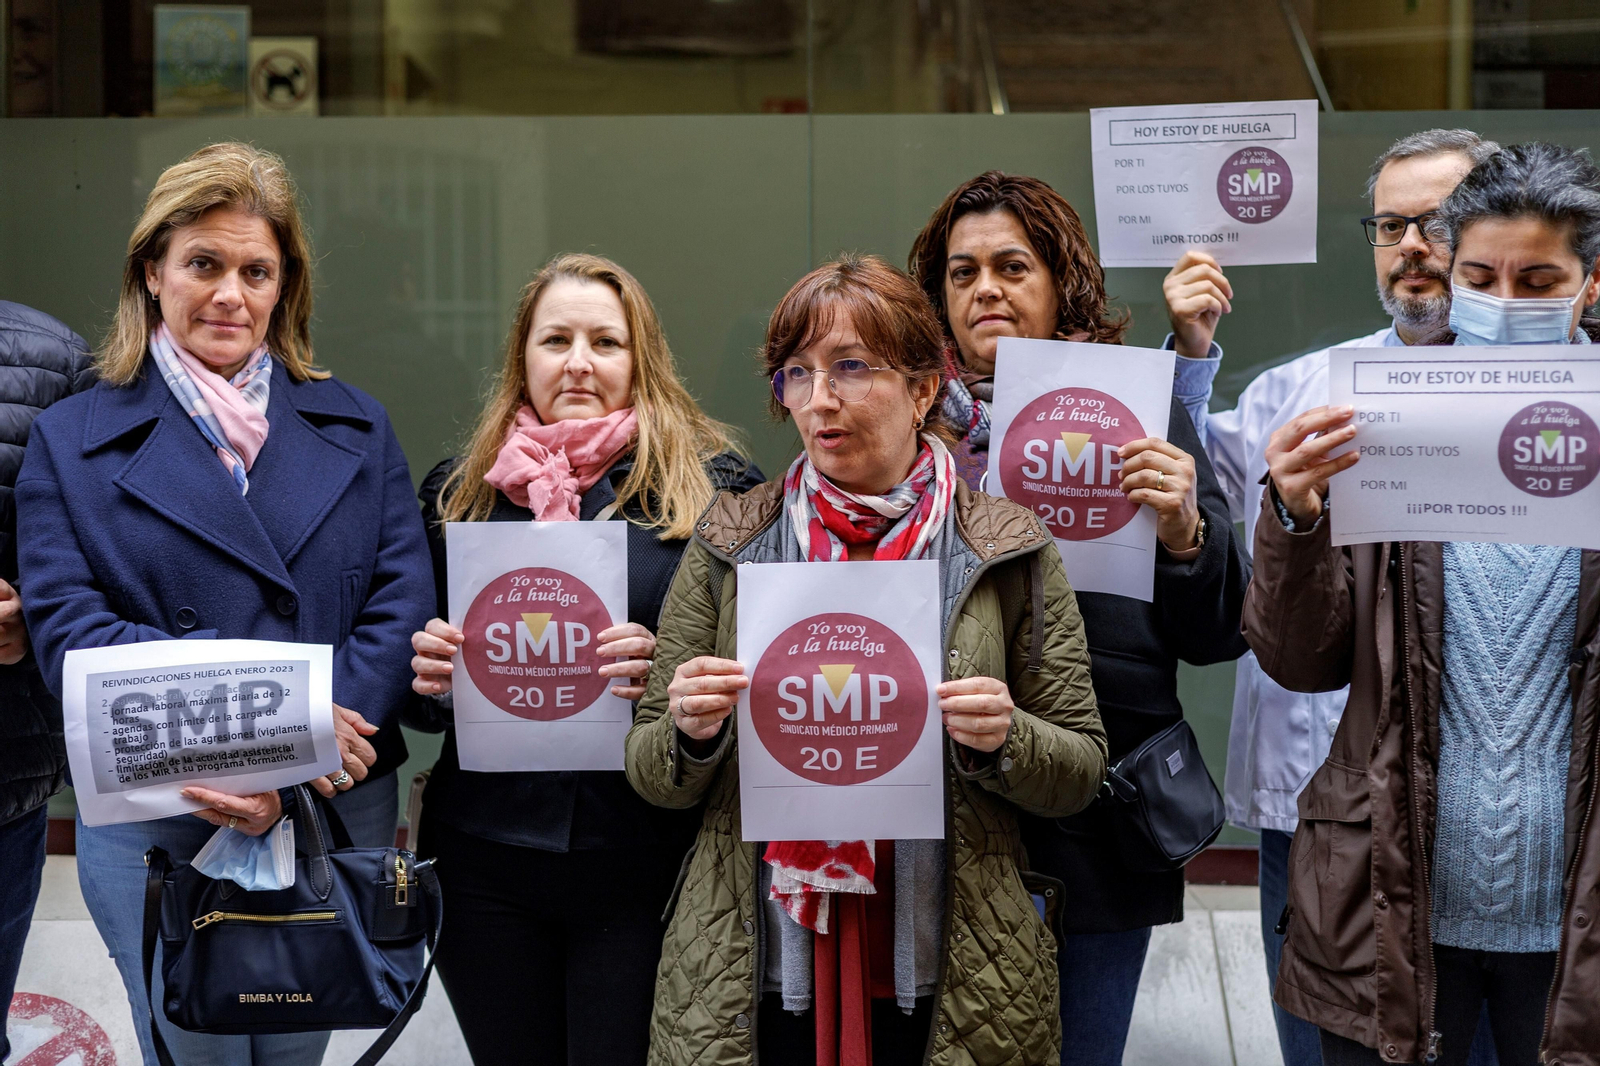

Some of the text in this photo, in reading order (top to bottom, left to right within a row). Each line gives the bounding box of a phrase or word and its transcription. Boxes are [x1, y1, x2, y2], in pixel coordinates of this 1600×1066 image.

[1134, 122, 1271, 138] HOY ESTOY DE HUELGA
[1114, 158, 1144, 168] POR TI
[1250, 156, 1275, 166] huelga
[1116, 184, 1188, 194] POR LOS TUYOS
[1228, 172, 1281, 195] SMP
[1237, 205, 1272, 218] 20 E
[1118, 215, 1151, 224] POR MI
[1187, 234, 1223, 244] TODOS
[1227, 233, 1239, 242] !!!
[1388, 370, 1574, 384] HOY ESTOY DE HUELGA
[1055, 394, 1105, 411] Yo voy
[1533, 406, 1547, 414] Yo
[1036, 407, 1120, 429] a la huelga
[1359, 412, 1400, 422] POR TI
[1530, 415, 1541, 424] la
[1544, 414, 1580, 427] huelga
[1360, 445, 1460, 457] POR LOS TUYOS
[1513, 436, 1587, 464] SMP
[1021, 439, 1125, 485] SMP
[1022, 481, 1057, 495] SINDICATO
[1059, 483, 1089, 497] MÉDICO
[1360, 480, 1407, 490] POR MI
[1526, 477, 1574, 490] 20 E
[1038, 504, 1107, 528] 20 E
[1457, 504, 1506, 515] TODOS
[1511, 505, 1527, 516] !!!
[510, 575, 562, 589] Yo voy
[494, 588, 579, 607] a la huelga
[808, 622, 866, 638] Yo voy
[485, 621, 590, 663] SMP
[788, 636, 886, 657] a la huelga
[102, 672, 191, 688] REIVINDICACIONES
[194, 669, 231, 679] HUELGA
[235, 667, 266, 675] ENERO
[488, 665, 591, 676] SINDICATO MÉDICO PRIMARIA
[102, 699, 111, 707] 2.
[145, 692, 180, 702] Laboral
[111, 705, 148, 718] jornada
[152, 700, 186, 710] laboral
[190, 696, 228, 707] máxima
[232, 692, 259, 701] diaria
[263, 690, 274, 698] de
[507, 686, 576, 708] 20 E
[777, 674, 898, 721] SMP
[110, 680, 284, 754] SMP
[113, 715, 139, 725] horas
[113, 723, 152, 736] agendas
[157, 721, 173, 729] con
[178, 717, 205, 727] límite
[209, 715, 220, 723] de
[224, 713, 232, 721] la
[236, 710, 262, 720] carga
[266, 708, 277, 716] de
[780, 723, 898, 736] SINDICATO MÉDICO PRIMARIA
[114, 734, 148, 744] trabajo
[115, 741, 165, 756] protección
[169, 739, 181, 747] de
[185, 737, 197, 745] las
[202, 730, 254, 744] agresiones
[258, 724, 308, 738] (vigilantes
[116, 750, 168, 764] seguridad)
[117, 761, 164, 774] limitación
[169, 758, 181, 766] de
[184, 756, 193, 764] la
[196, 750, 239, 762] actividad
[243, 743, 294, 758] asistencial
[800, 746, 878, 771] 20 E
[119, 775, 131, 783] de
[134, 772, 148, 780] los
[152, 769, 170, 777] MIR
[198, 760, 244, 772] programa
[248, 755, 298, 766] formativo.
[239, 994, 313, 1003] BIMBA Y LOLA
